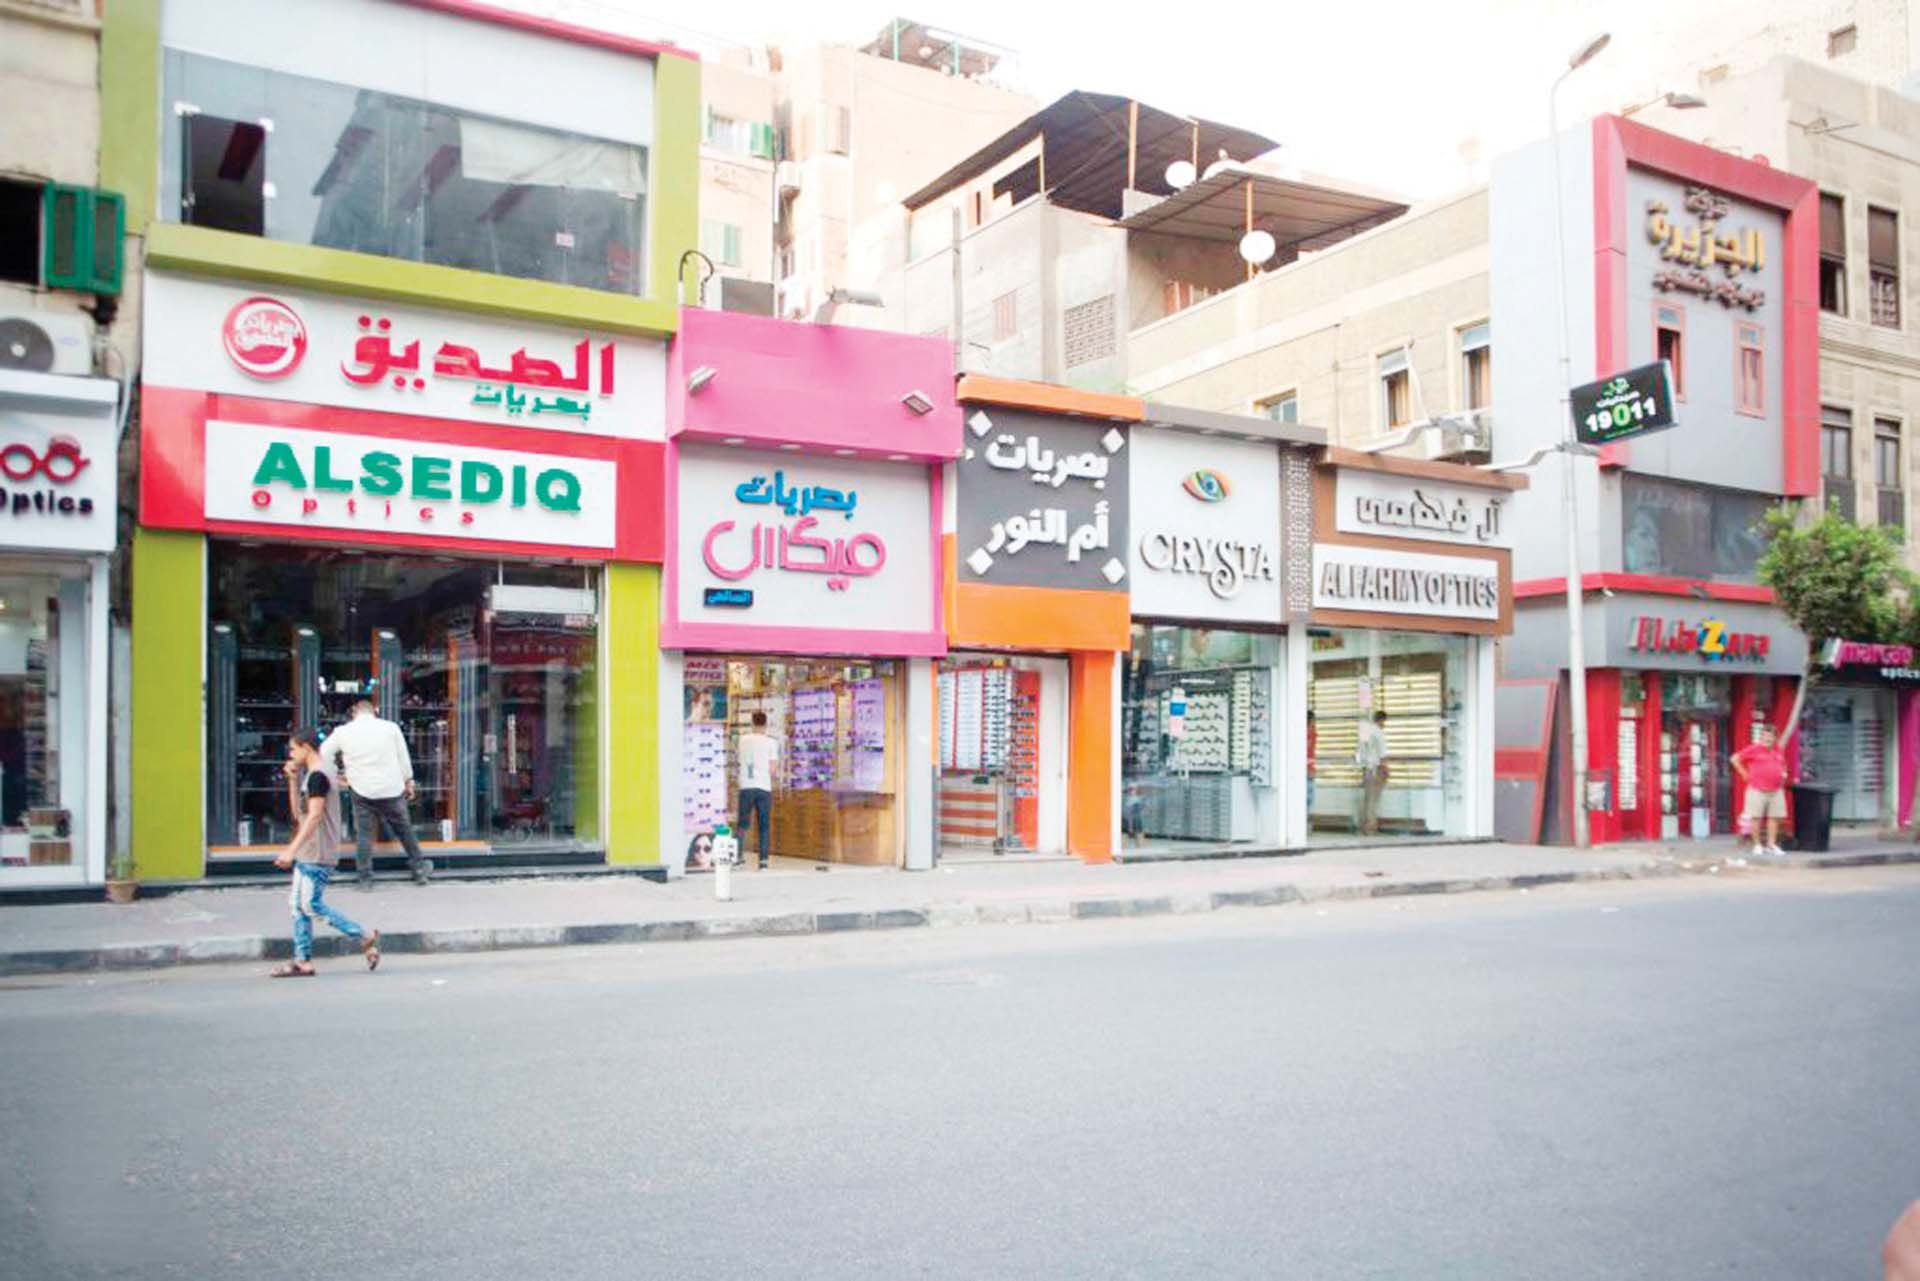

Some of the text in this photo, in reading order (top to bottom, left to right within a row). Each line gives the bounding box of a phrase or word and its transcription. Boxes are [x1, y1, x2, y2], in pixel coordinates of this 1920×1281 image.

[341, 315, 616, 397] الصديق
[471, 383, 591, 421] بصريات
[1586, 397, 1656, 432] 19011
[252, 442, 582, 512] ALSEDIQ
[985, 434, 1109, 489] بصريات
[735, 470, 858, 519] بصريات
[986, 500, 1110, 562] أم النور
[1139, 533, 1276, 600] CRYSTA
